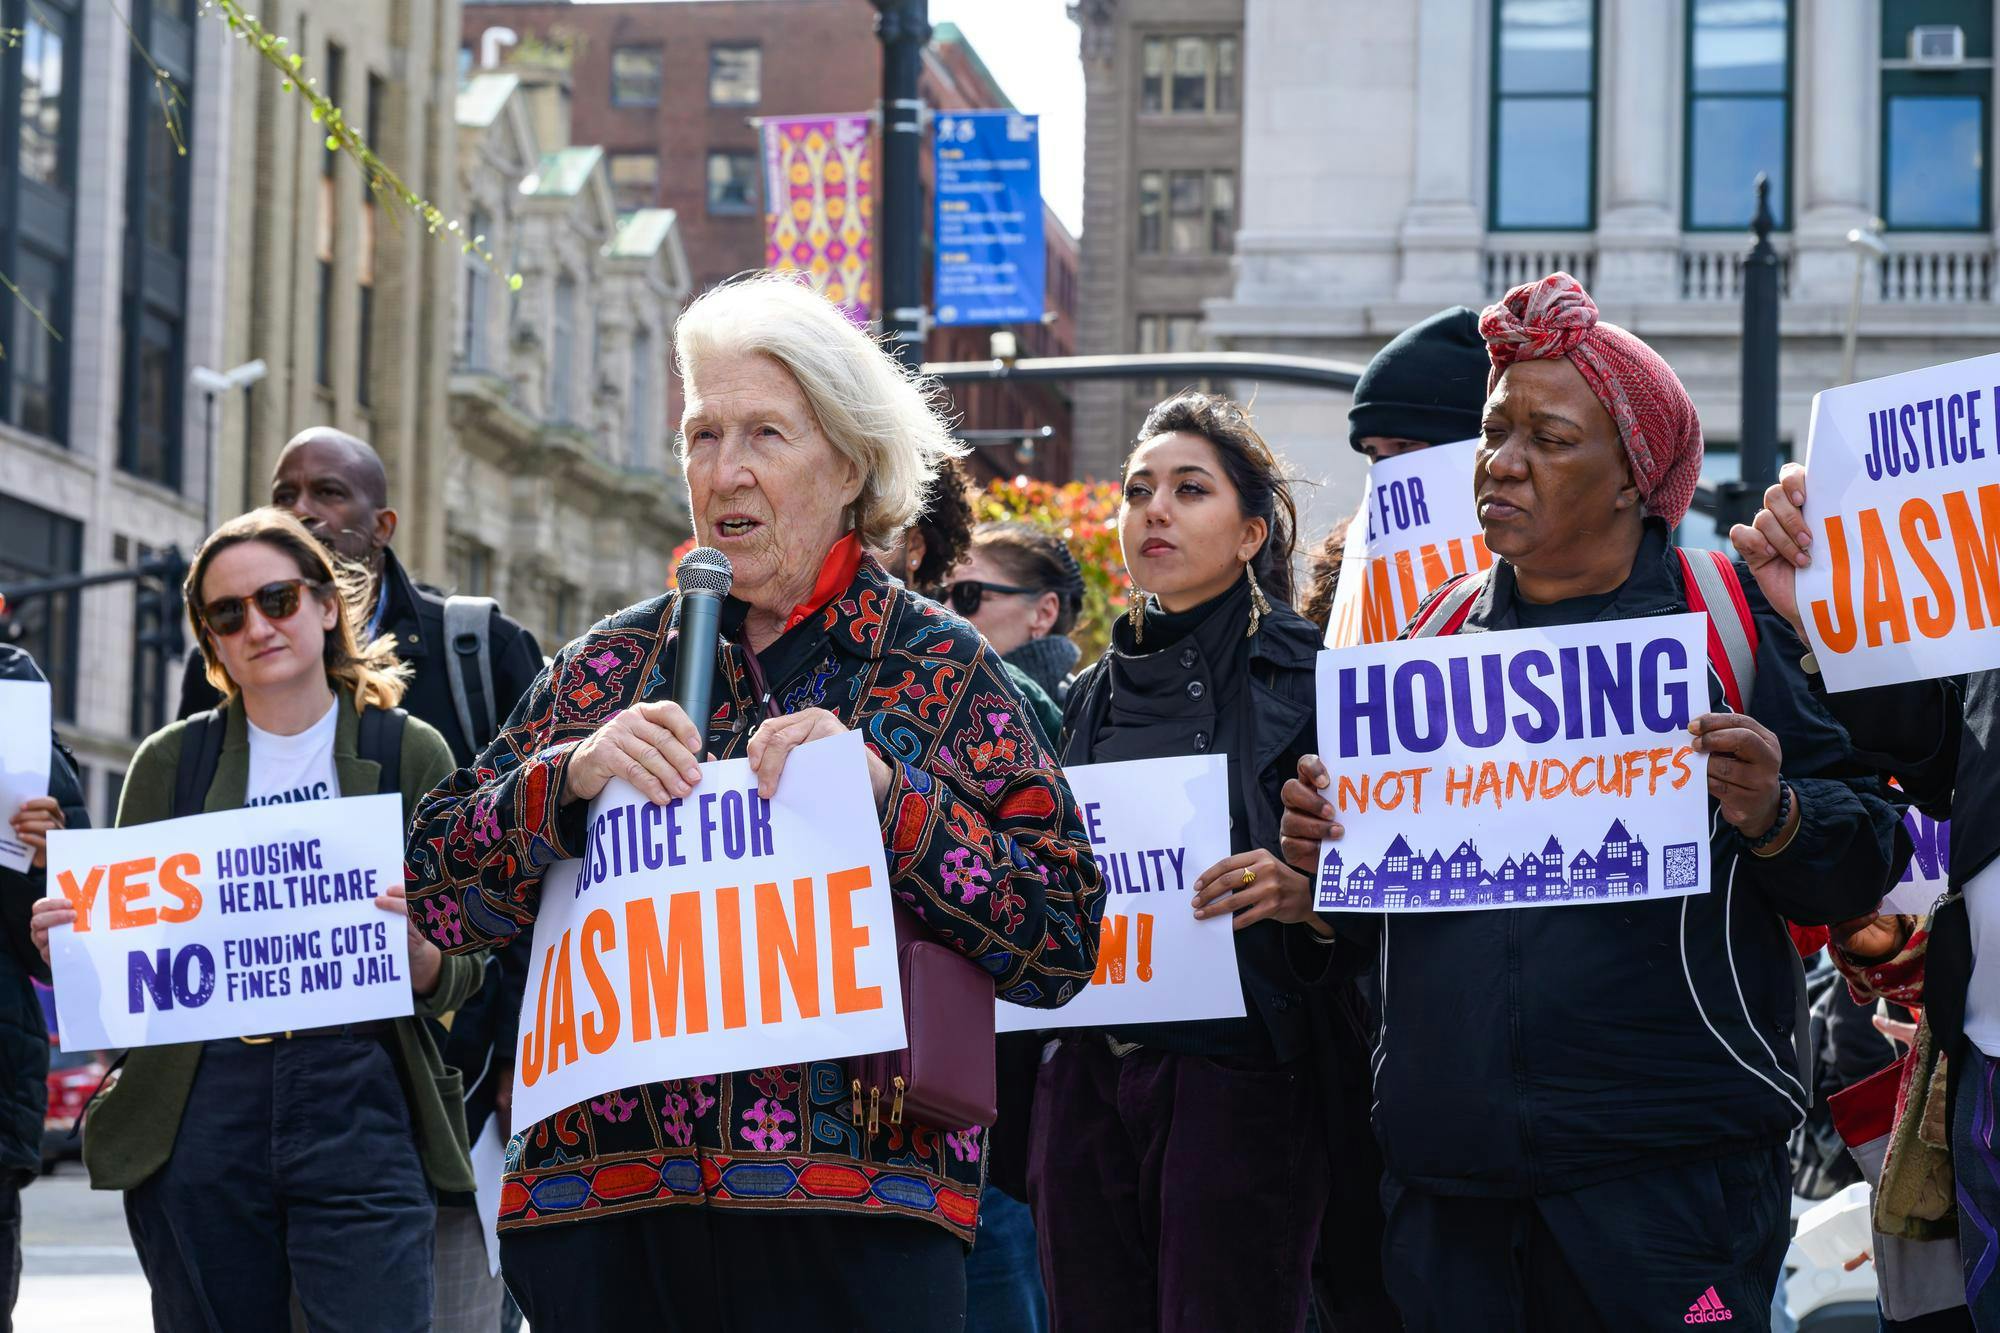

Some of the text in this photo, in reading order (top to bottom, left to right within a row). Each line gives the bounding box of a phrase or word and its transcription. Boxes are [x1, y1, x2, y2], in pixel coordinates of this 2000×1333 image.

[1865, 390, 1985, 481] JUSTICE
[1377, 476, 1430, 535] FOR
[1811, 484, 2000, 653] JASM
[1339, 638, 1689, 758] HOUSING
[1338, 746, 1693, 814] NOT HANDCUFFS
[699, 788, 774, 862] FOR
[57, 853, 203, 933] YES
[219, 868, 378, 914] HEALTHCARE
[1093, 848, 1185, 896] BILITY
[332, 922, 387, 960] CUTS
[1090, 912, 1154, 985] N!
[128, 944, 215, 1014] NO
[301, 959, 342, 994] AND
[521, 866, 883, 1087] JASMINE
[1684, 1309, 1733, 1324] adidas
